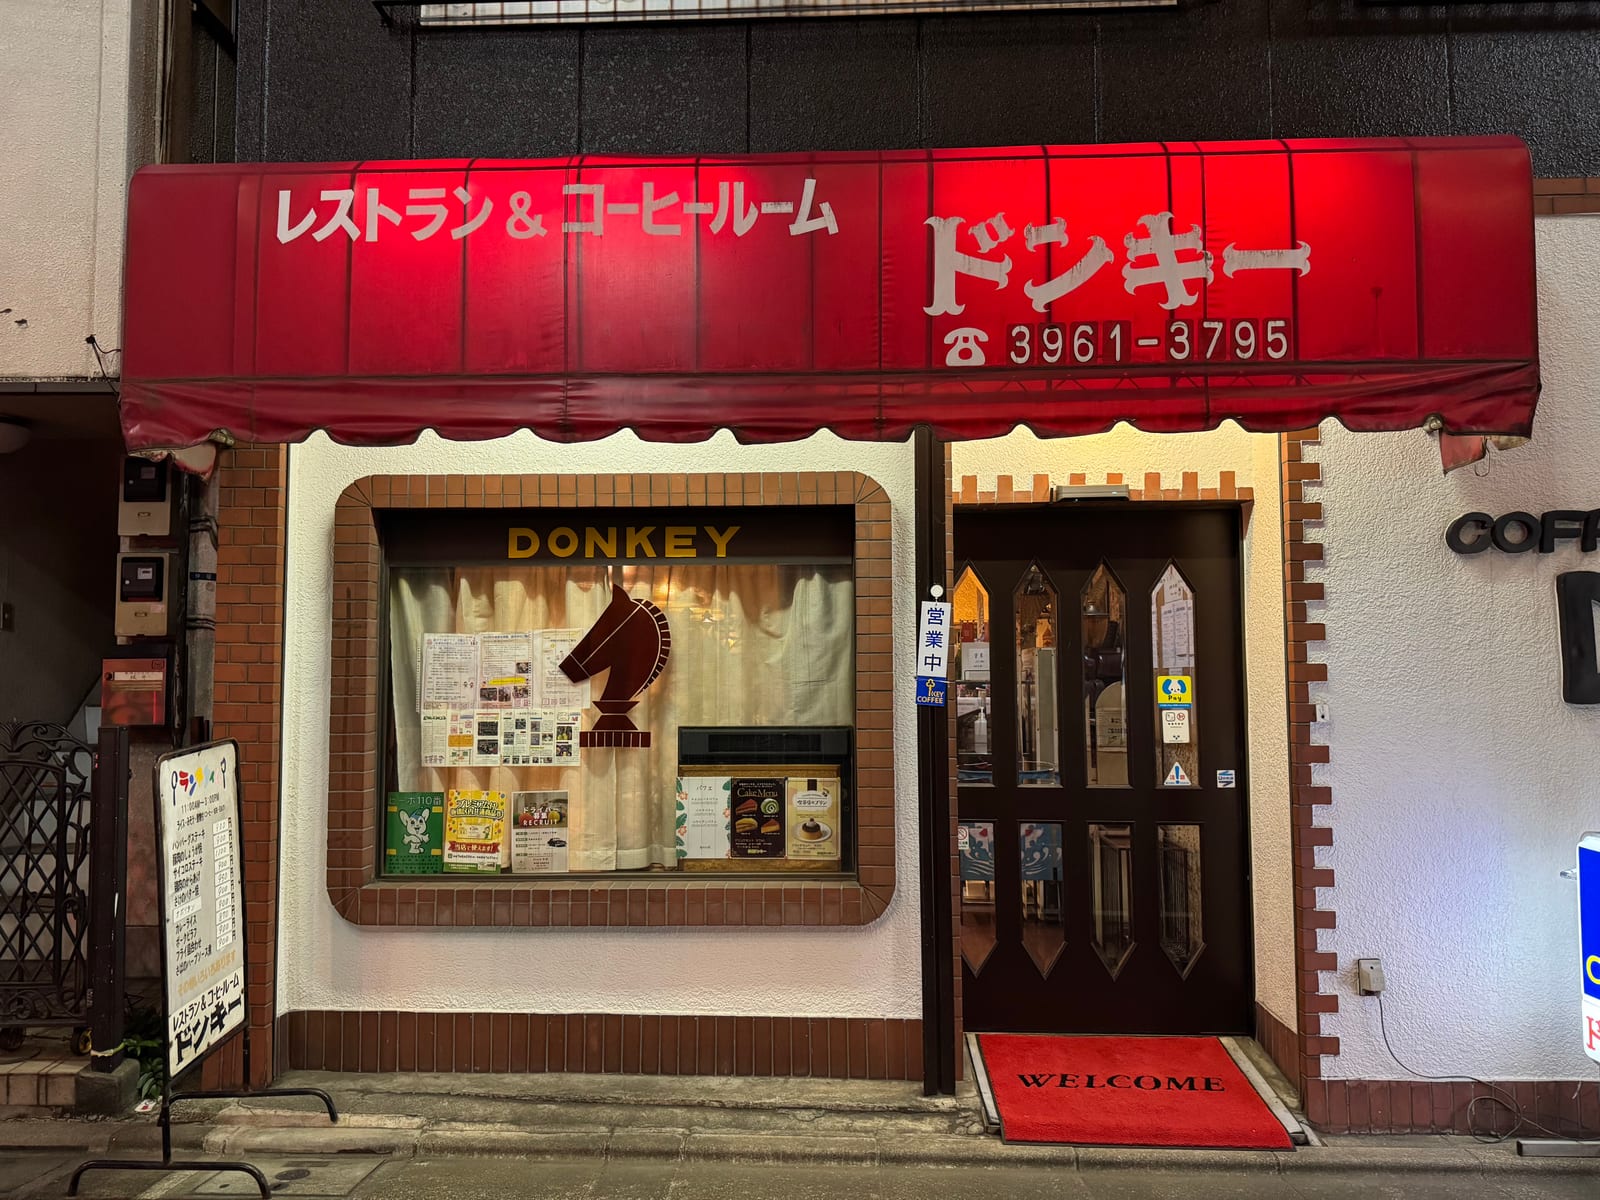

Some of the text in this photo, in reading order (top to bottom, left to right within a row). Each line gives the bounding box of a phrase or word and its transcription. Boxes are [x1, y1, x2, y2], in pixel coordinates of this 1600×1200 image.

[276, 189, 495, 244] レストラン
[562, 178, 839, 237] コーヒールーム
[923, 211, 1311, 316] ドンキー
[1010, 320, 1289, 364] 3961-3795
[508, 526, 741, 559] DONKEY
[924, 606, 945, 672] 営業中
[917, 696, 944, 704] COFFEE
[737, 787, 778, 798] Cake Menu
[174, 1002, 200, 1031] レストラン
[207, 973, 239, 1006] コーヒールーム
[174, 994, 241, 1066] ドンキー
[1016, 1072, 1226, 1093] WELCOME
